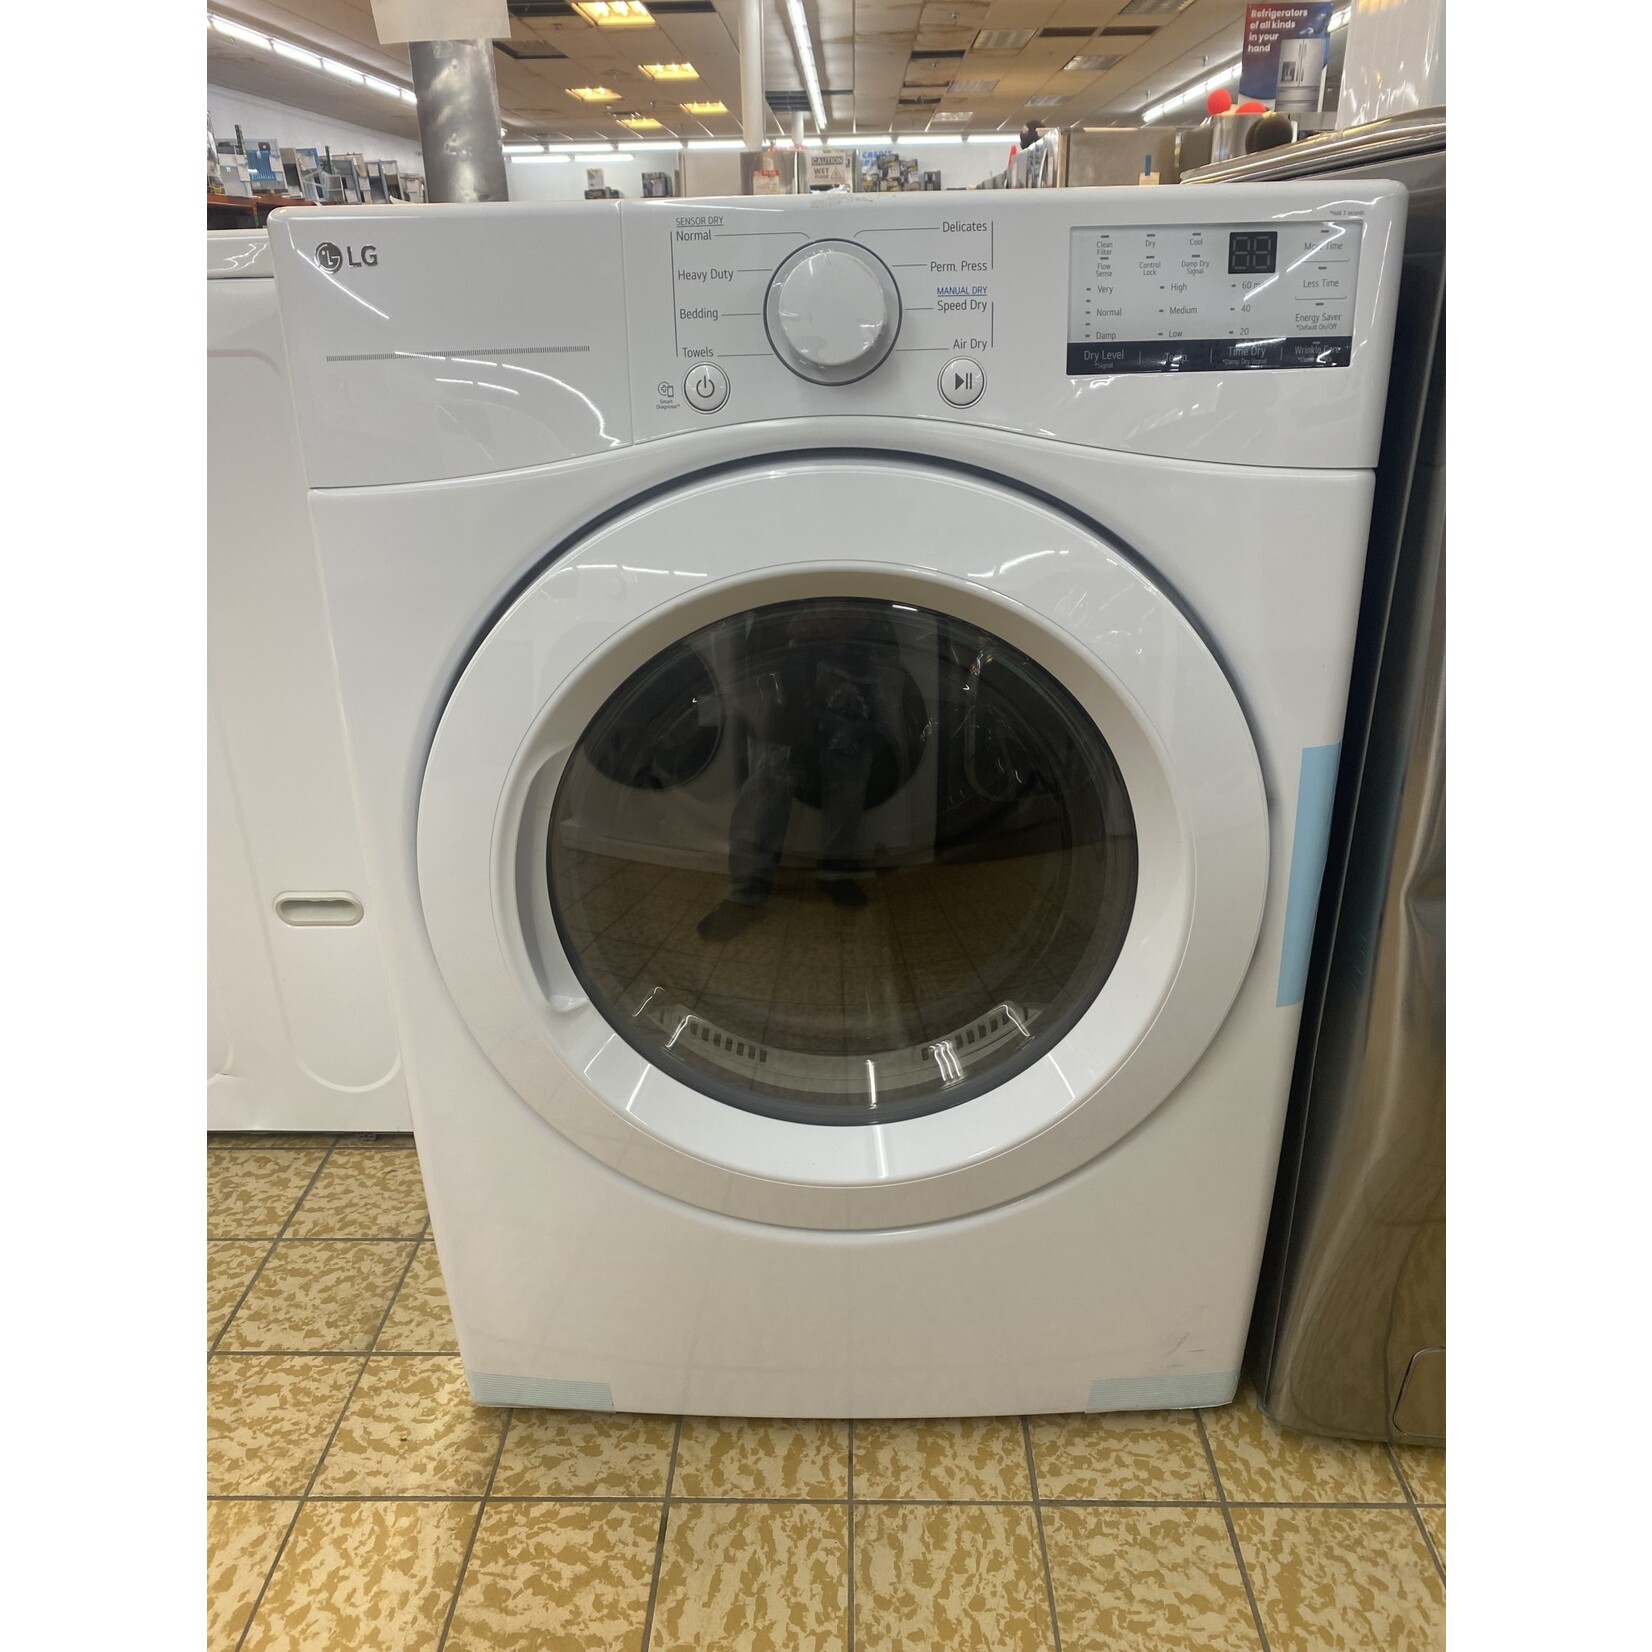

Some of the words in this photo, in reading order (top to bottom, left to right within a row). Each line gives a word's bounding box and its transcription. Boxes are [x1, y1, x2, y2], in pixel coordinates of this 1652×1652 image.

[1251, 9, 1308, 19] Refrigerators
[1250, 21, 1259, 29] of
[1260, 21, 1271, 29] all
[1272, 20, 1296, 29] kinds
[1249, 32, 1257, 41] in
[1259, 33, 1279, 43] your
[1248, 44, 1271, 52] hand
[812, 157, 843, 165] CAUTION
[676, 217, 706, 226] SENSOR
[708, 216, 724, 225] DRY
[942, 221, 987, 232] Delicates
[676, 229, 712, 241] Normal
[1145, 240, 1156, 248] Dry
[347, 245, 378, 267] LG
[930, 261, 958, 272] Perm.
[961, 260, 987, 271] Press
[1200, 260, 1209, 268] Dry
[678, 270, 707, 282] Heavy
[710, 268, 734, 281] Duty
[1171, 283, 1187, 293] High
[1242, 281, 1252, 289] 60
[1303, 280, 1319, 288] Less
[1322, 279, 1339, 287] Time
[937, 287, 969, 295] MANUAL
[972, 286, 987, 294] DRY
[1098, 285, 1114, 295] Very
[937, 300, 967, 313] Speed
[970, 299, 987, 312] Dry
[1170, 306, 1197, 314] Medium
[1241, 304, 1251, 312] 40
[680, 308, 719, 321] Bedding
[1096, 308, 1122, 316] Normal
[1295, 314, 1319, 323] Energy
[1322, 313, 1342, 321] Saver
[1096, 332, 1116, 340] Damp
[953, 339, 967, 349] Air
[970, 338, 987, 351] Dry
[1295, 345, 1322, 354] Wrinkle
[682, 347, 714, 358] Towels
[1084, 350, 1099, 361] Dry
[1102, 350, 1124, 359] Level
[1228, 347, 1248, 356] Time
[1251, 346, 1266, 358] Dry
